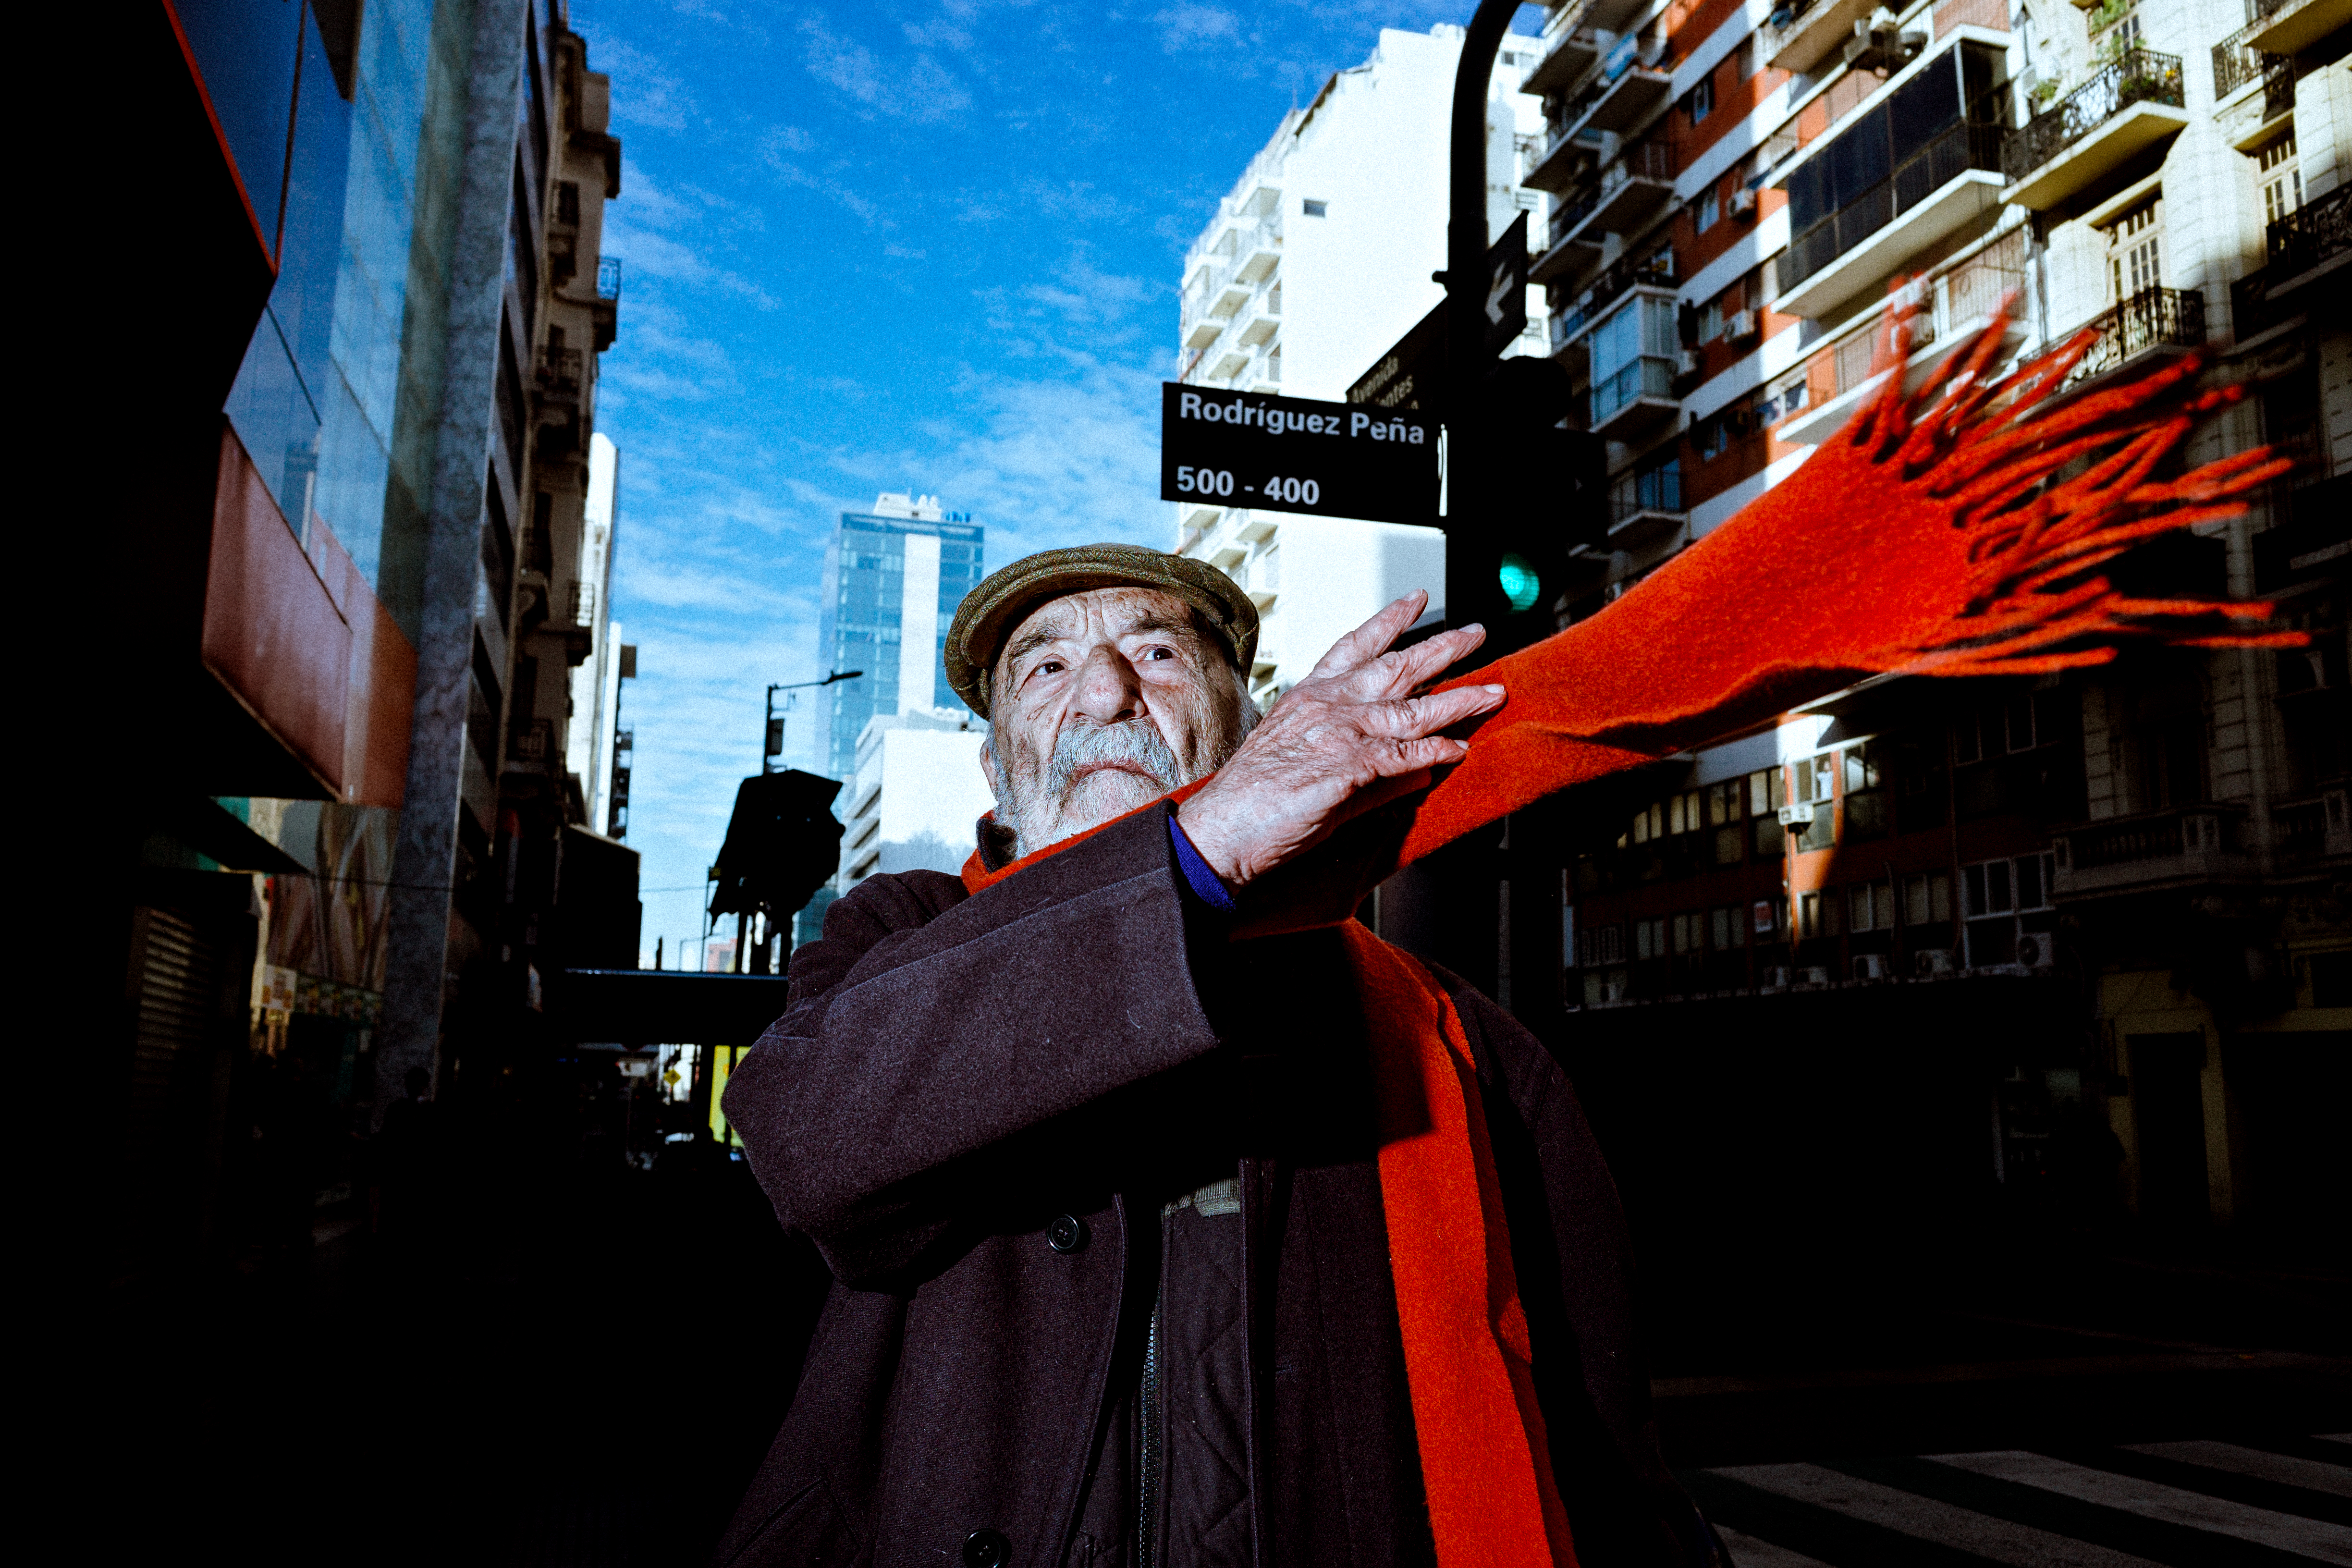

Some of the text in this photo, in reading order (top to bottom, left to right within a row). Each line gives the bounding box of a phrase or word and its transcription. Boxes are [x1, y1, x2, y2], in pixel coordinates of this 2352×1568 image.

[1180, 392, 1425, 445] Rodríguez Peña
[1177, 465, 1235, 497] 500
[1263, 476, 1320, 505] 400
